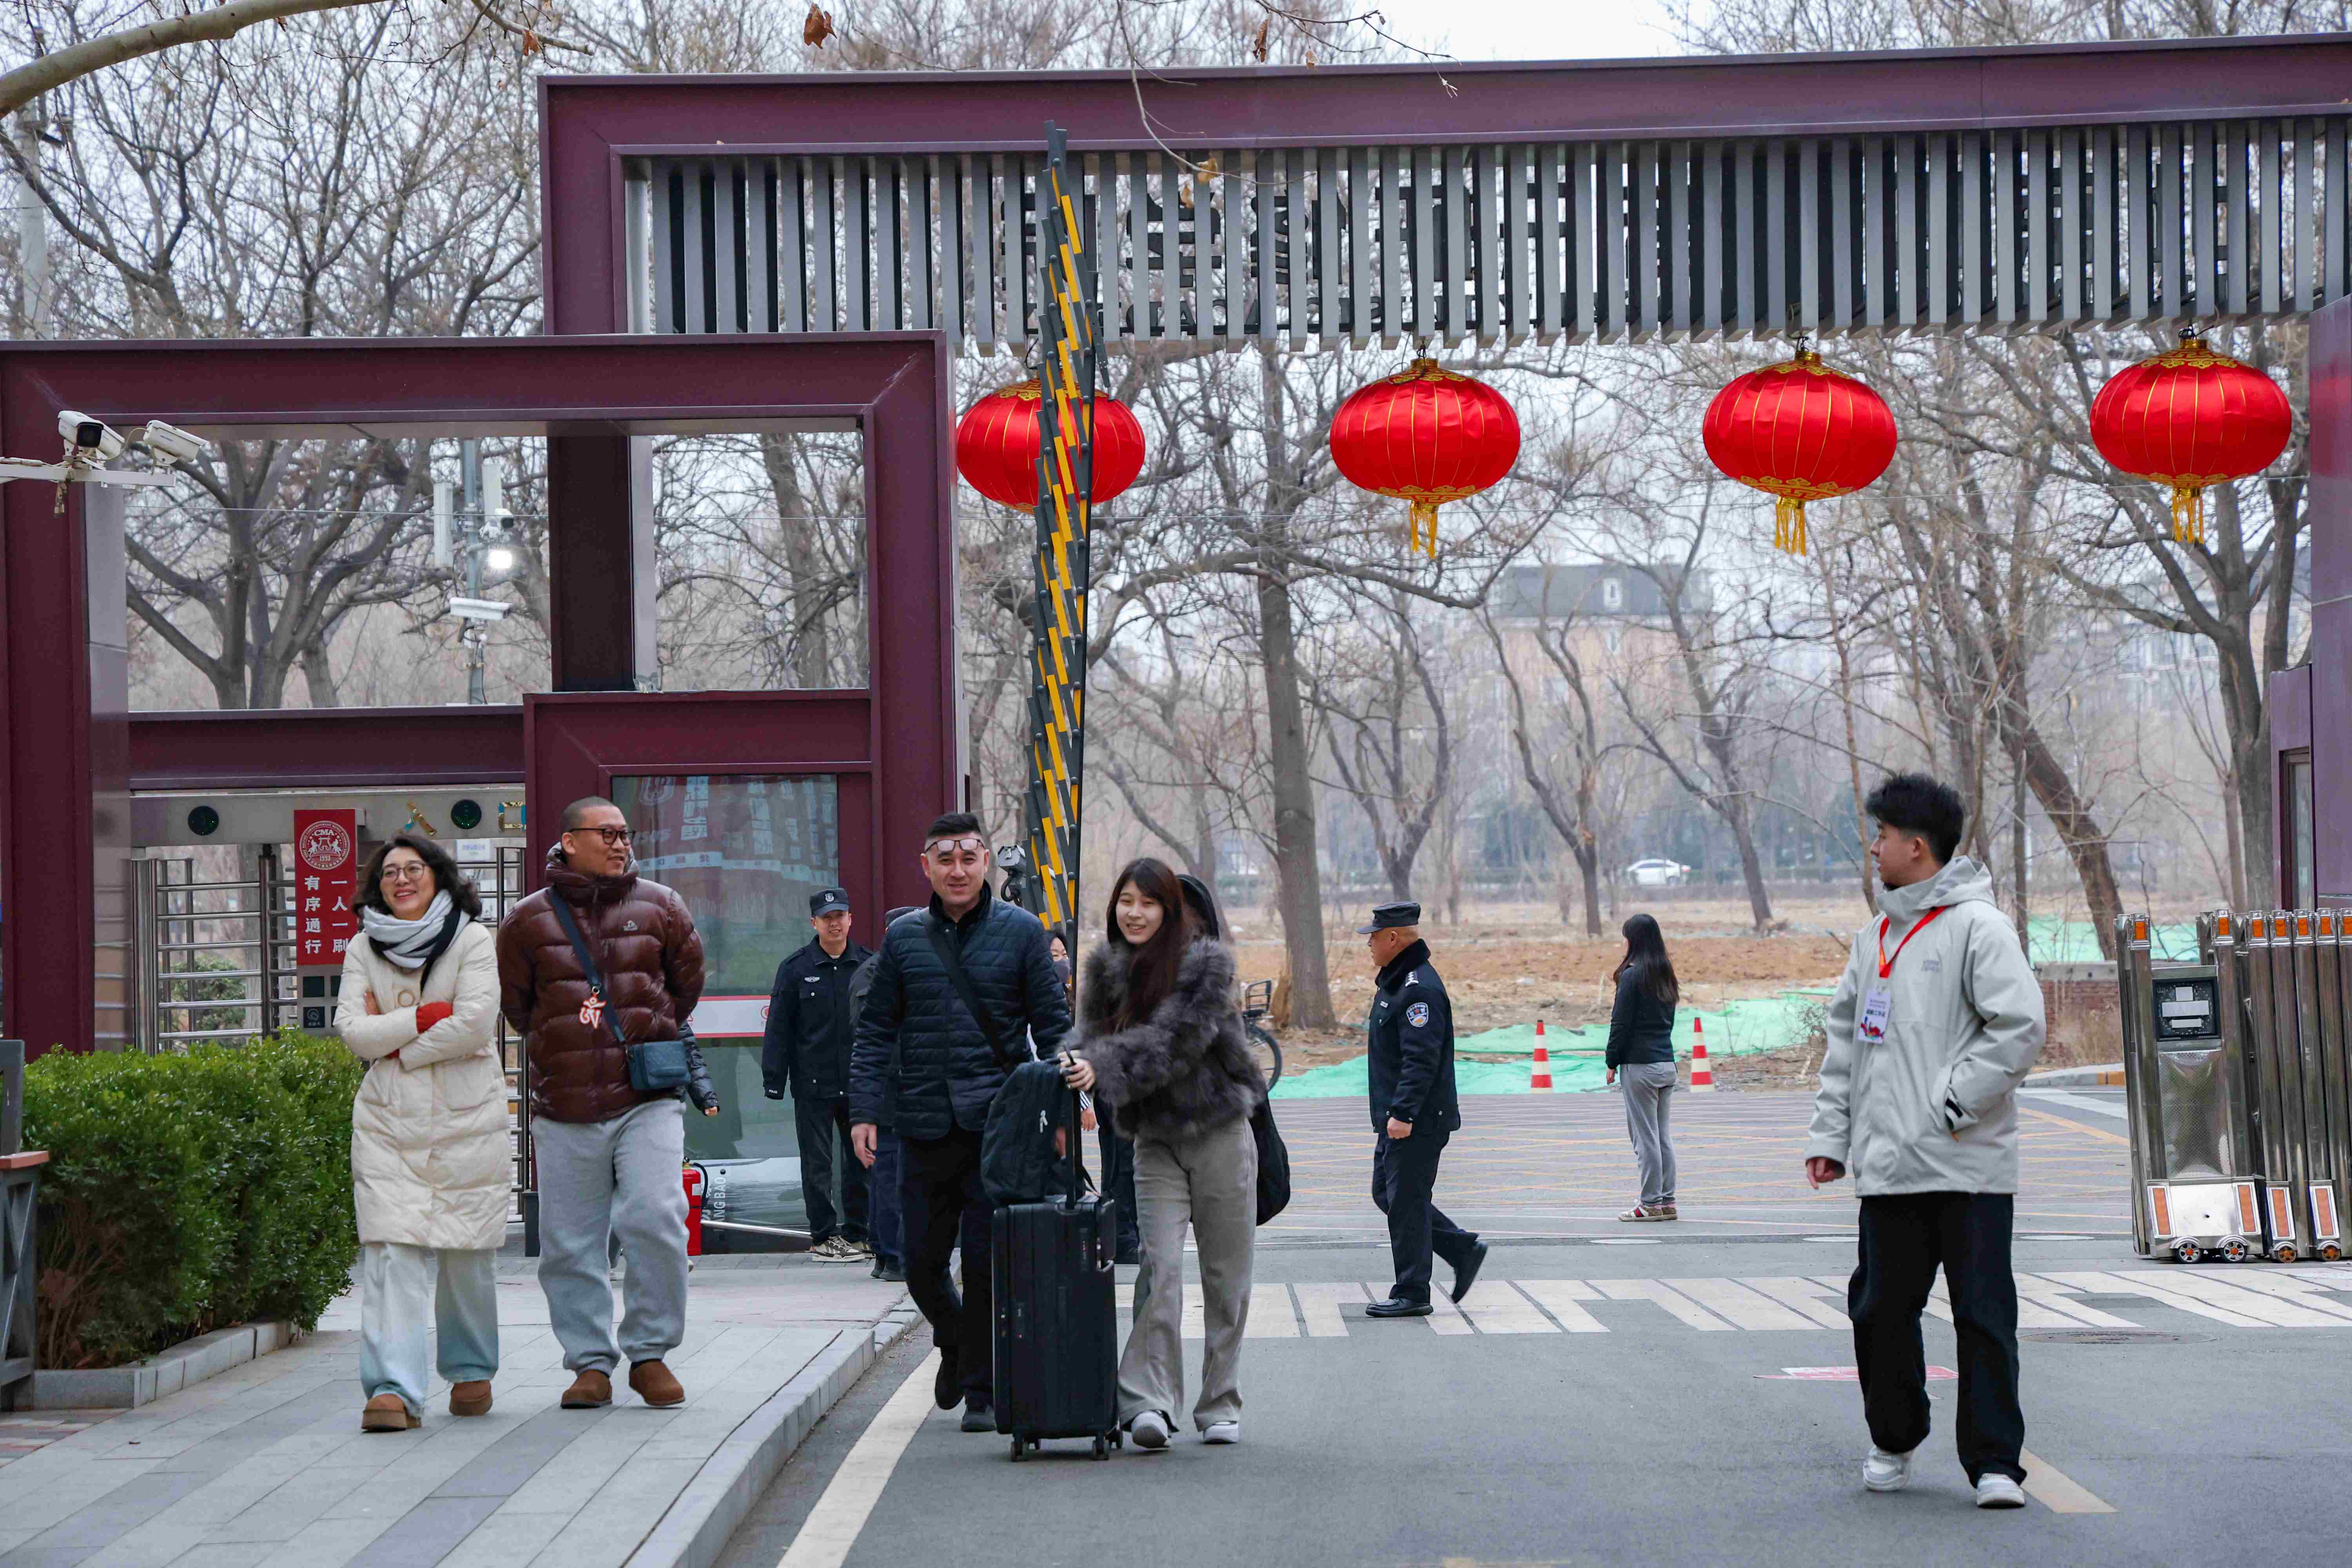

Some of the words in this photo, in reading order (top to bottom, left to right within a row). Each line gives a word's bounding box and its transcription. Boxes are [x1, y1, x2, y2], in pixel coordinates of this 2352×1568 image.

[304, 875, 321, 954] 有序通行
[331, 880, 349, 953] 一人一刷
[714, 1177, 726, 1198] BAO
